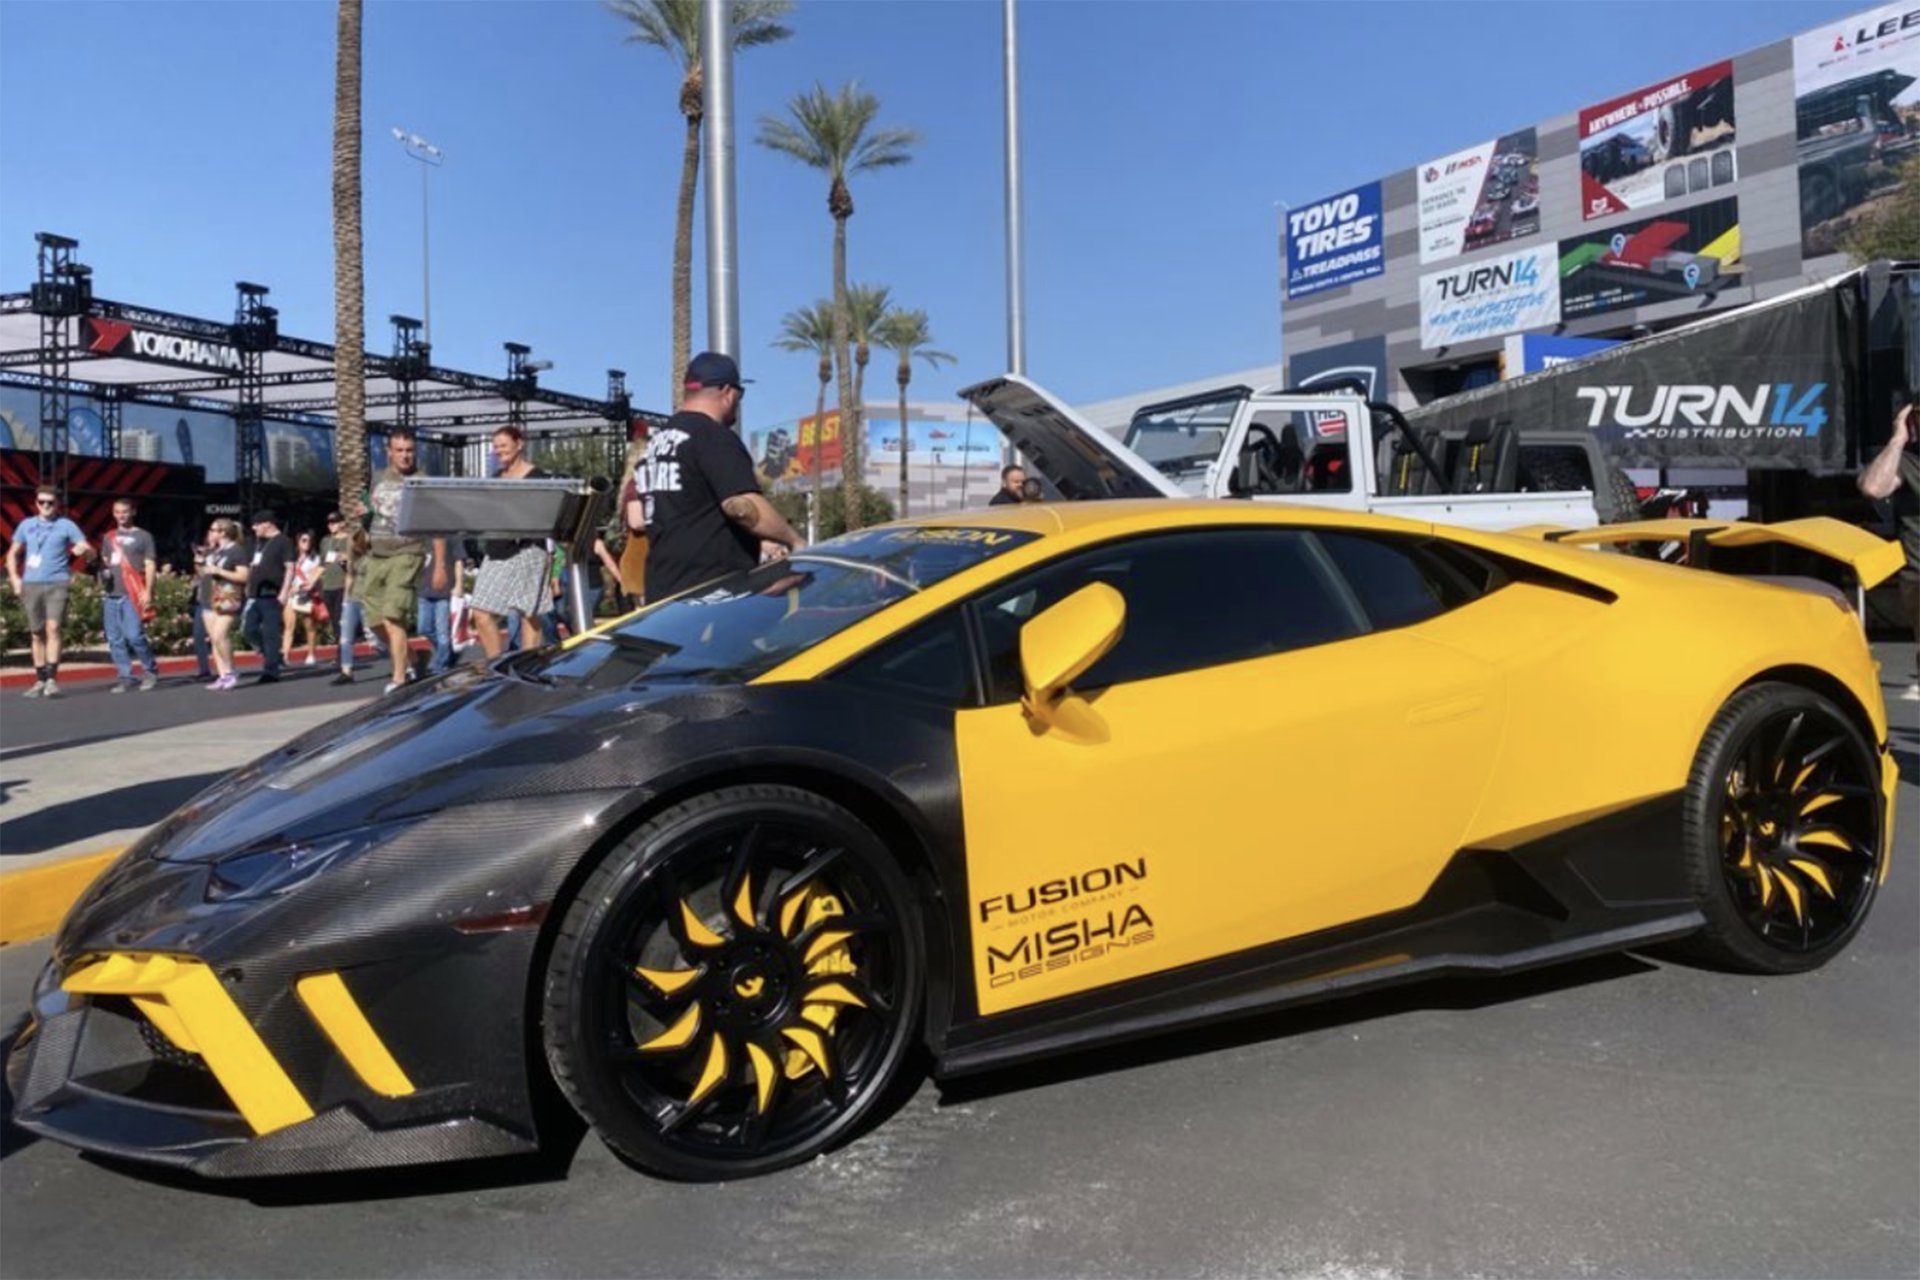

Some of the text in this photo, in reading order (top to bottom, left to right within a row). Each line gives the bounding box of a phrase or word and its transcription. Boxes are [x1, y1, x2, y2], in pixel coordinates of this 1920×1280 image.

[1290, 194, 1359, 236] TOYO
[1296, 215, 1373, 260] TIRES
[1303, 245, 1381, 278] TREADPASS
[1437, 256, 1538, 300] TURN14
[131, 329, 243, 370] YOKOHAMA
[1577, 383, 1829, 437] TURN14
[1656, 427, 1803, 438] DISTRIBUTION
[979, 857, 1147, 923] FUSION
[987, 904, 1153, 975] MISHA
[990, 930, 1155, 989] DESIGNS
